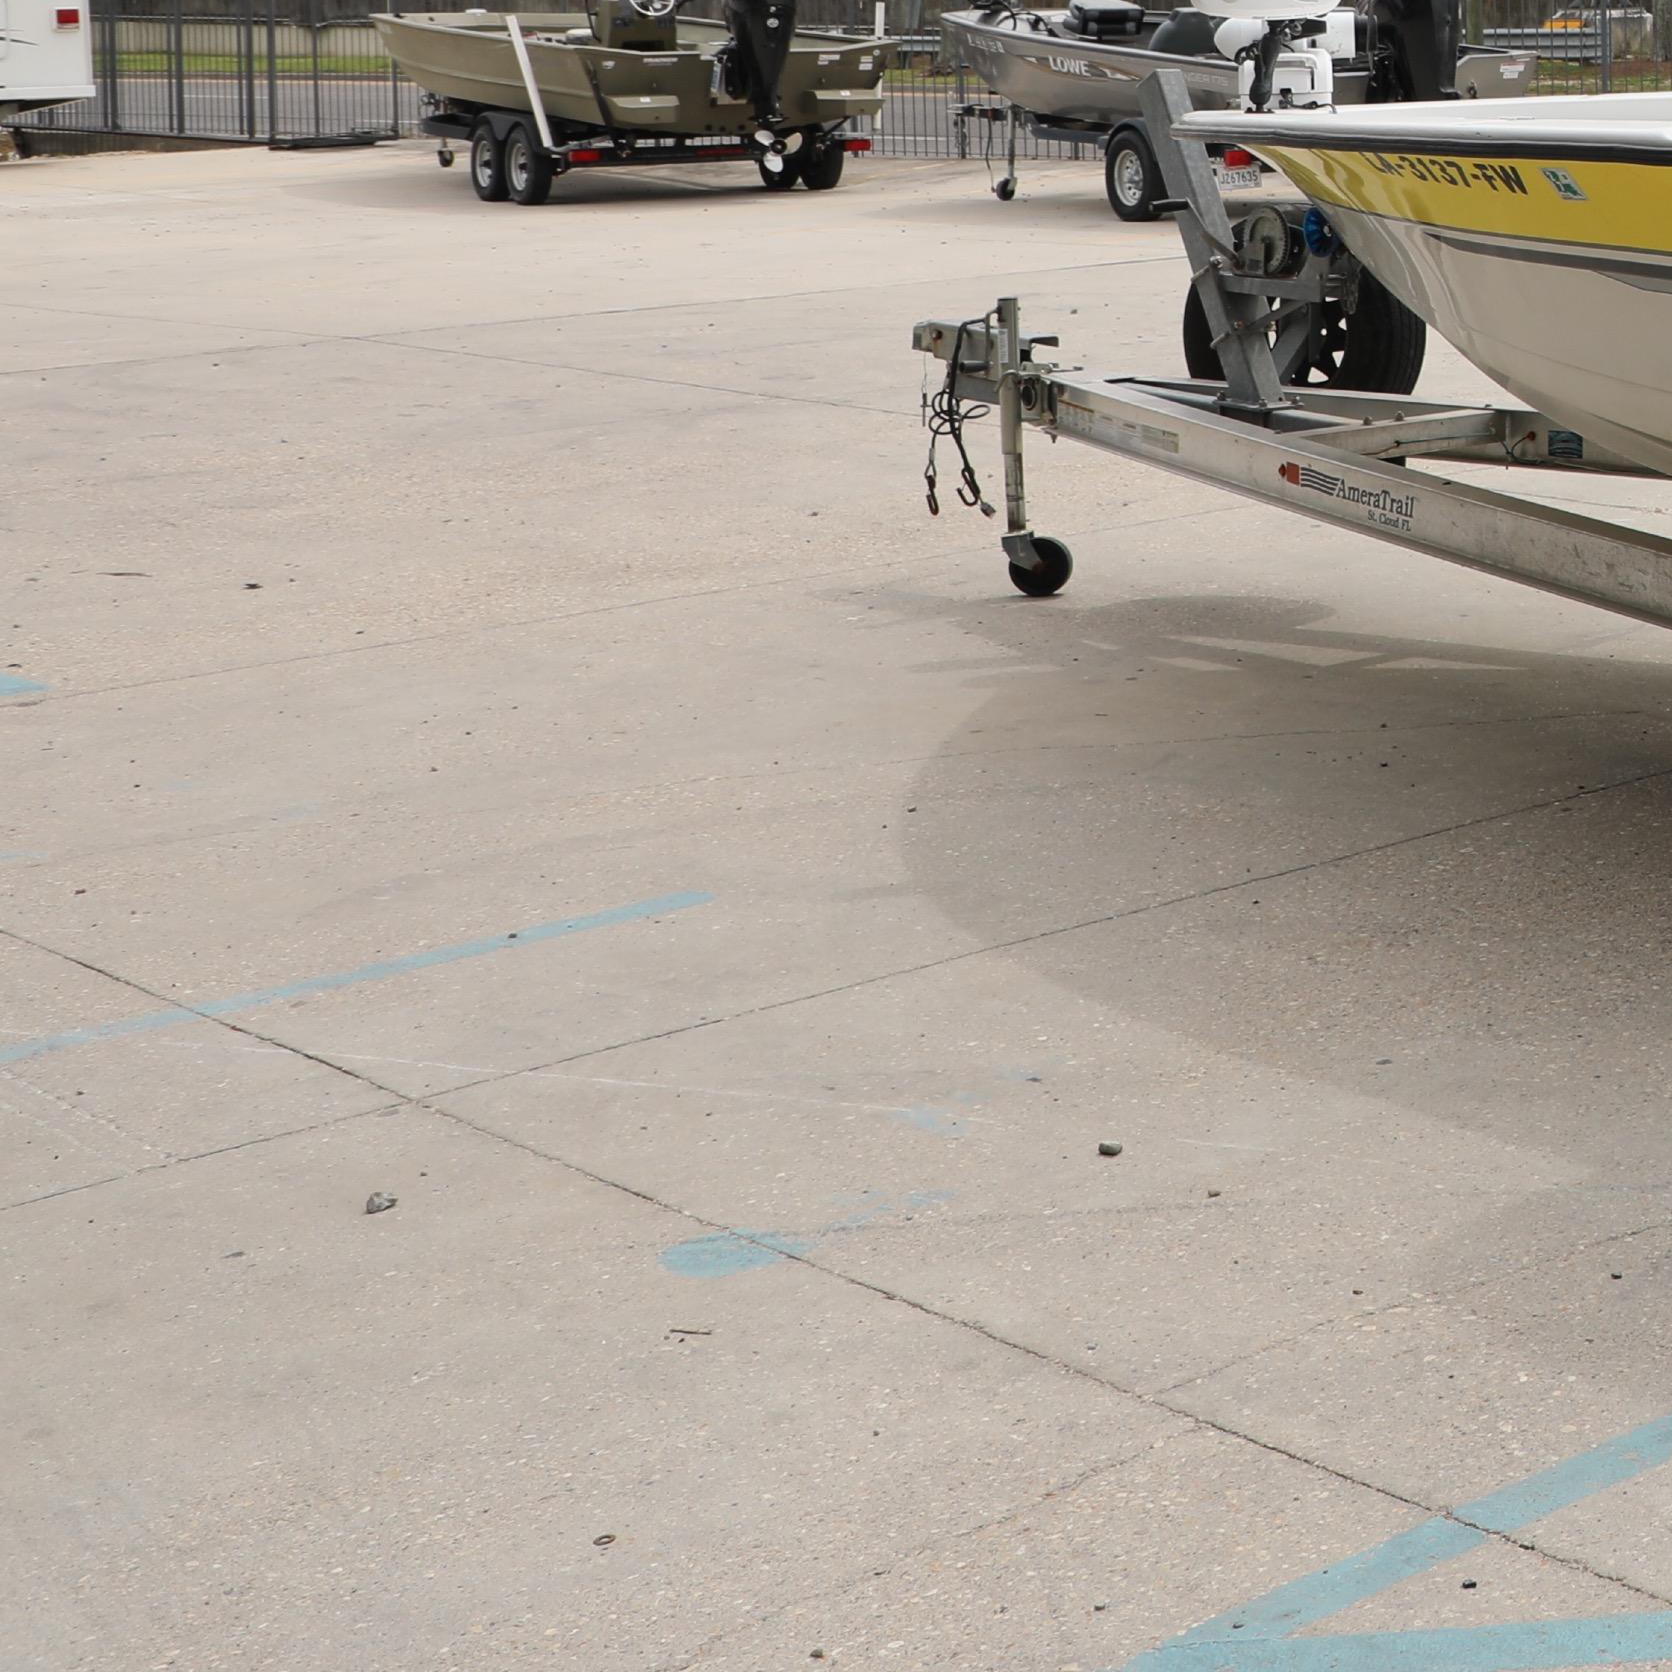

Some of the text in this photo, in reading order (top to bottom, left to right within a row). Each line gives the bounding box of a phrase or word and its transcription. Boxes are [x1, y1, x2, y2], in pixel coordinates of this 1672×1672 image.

[1048, 55, 1091, 76] LOWE
[1359, 152, 1528, 196] LA-3137-FW
[1336, 478, 1416, 519] AmeraTrail
[1367, 510, 1412, 531] St. Cloud FL
